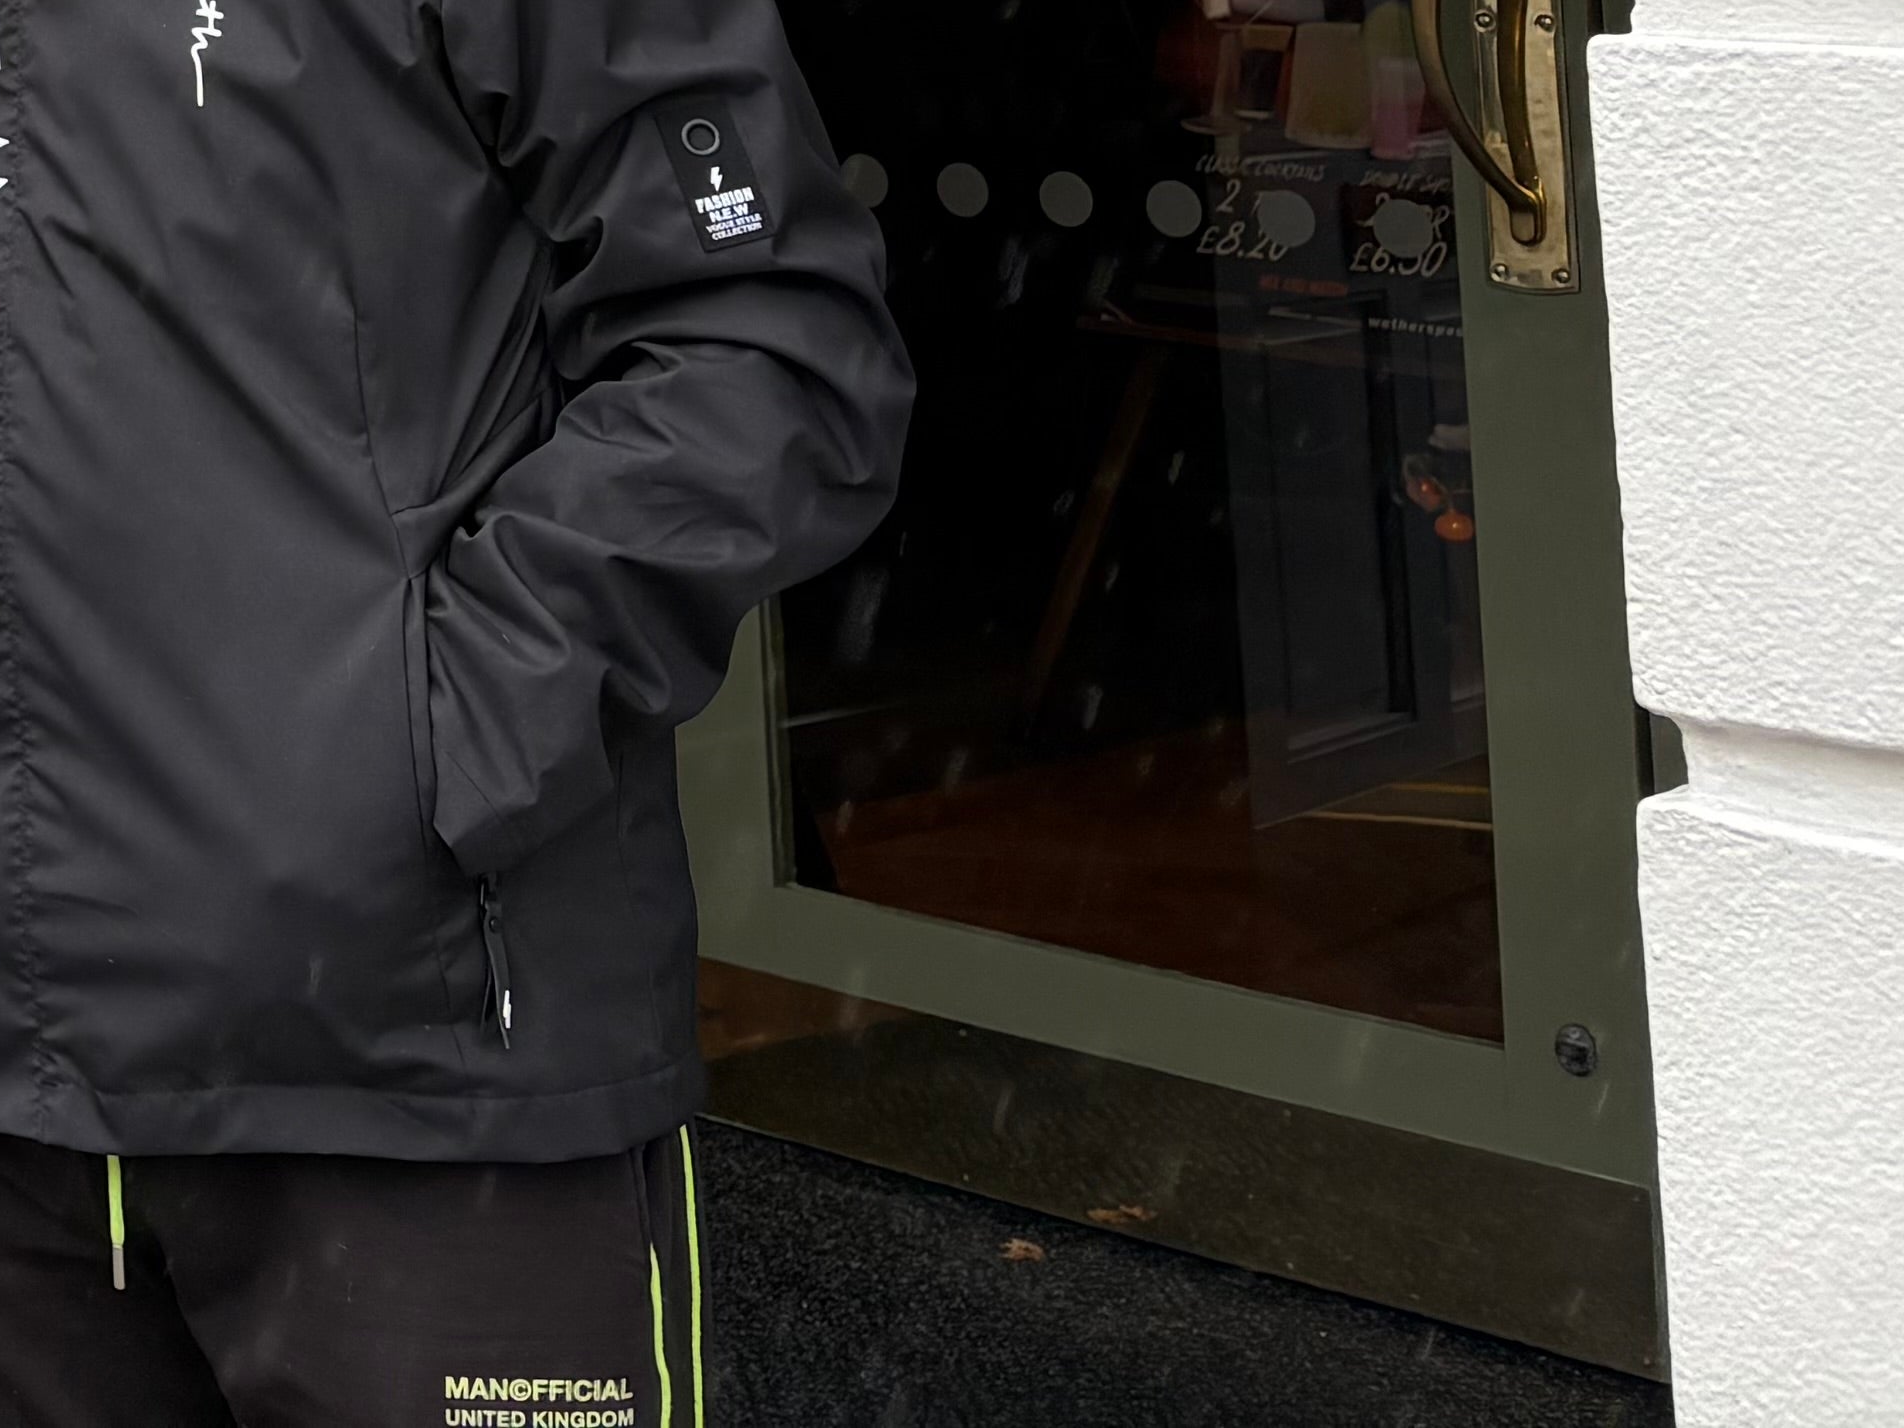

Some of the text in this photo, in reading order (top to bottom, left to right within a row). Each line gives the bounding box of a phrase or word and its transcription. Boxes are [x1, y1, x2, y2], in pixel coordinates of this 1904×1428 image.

[695, 187, 755, 214] FASHION
[445, 1407, 634, 1428] UNITED KINGDOM
